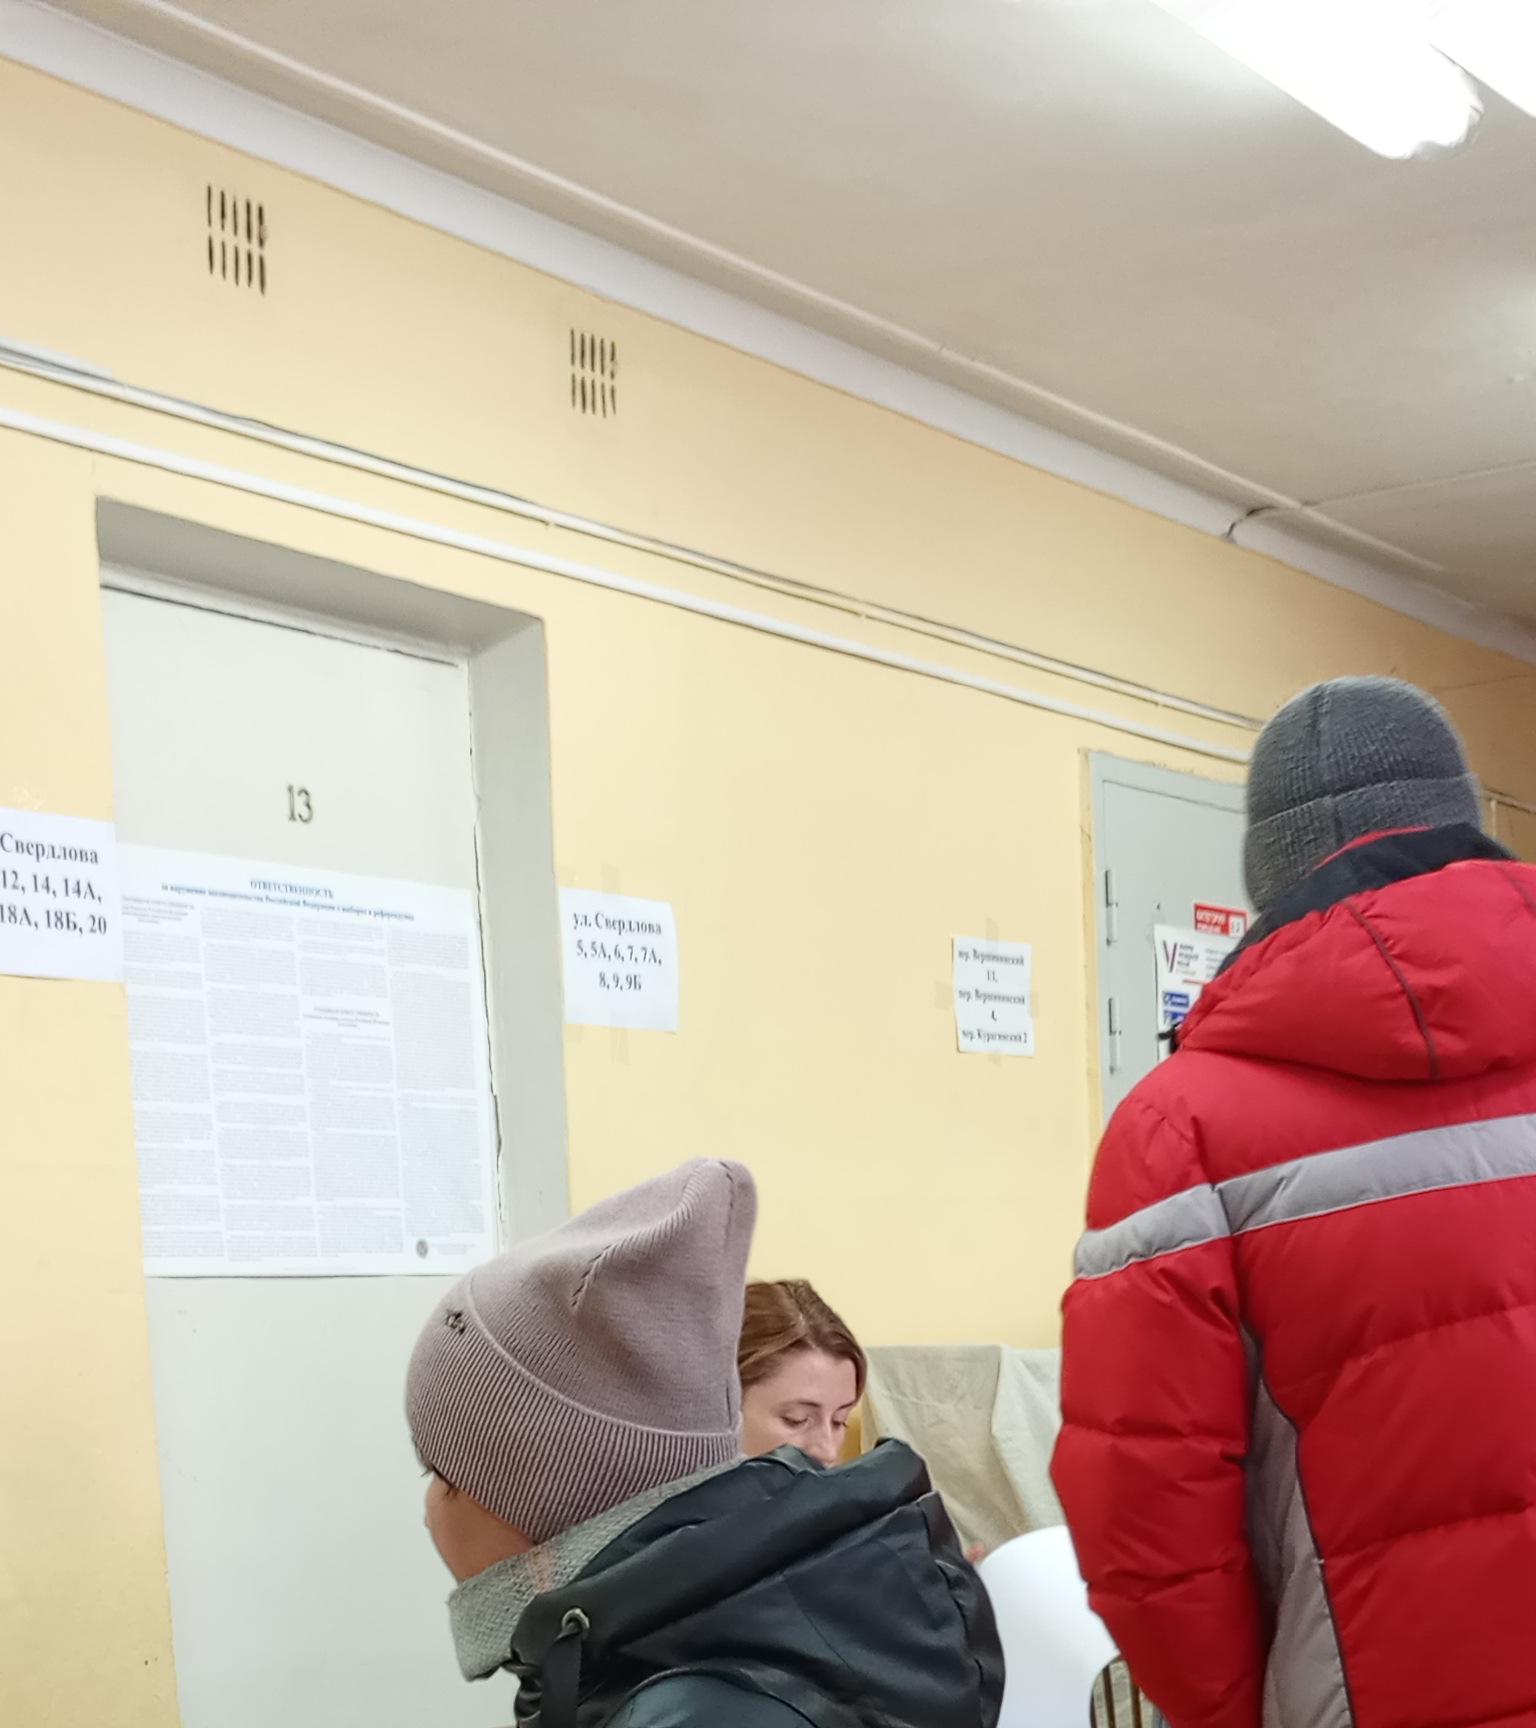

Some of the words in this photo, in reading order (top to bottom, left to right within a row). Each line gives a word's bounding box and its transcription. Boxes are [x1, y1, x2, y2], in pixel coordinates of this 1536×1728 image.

[286, 784, 314, 825] 13
[0, 832, 100, 865] Свердлова
[1, 868, 26, 895] 12,
[32, 873, 58, 899] 14,
[63, 877, 103, 904] 14А,
[45, 908, 83, 936] 18Б,
[87, 914, 108, 936] 20
[573, 911, 592, 931] ул.
[595, 911, 663, 936] Свердлова
